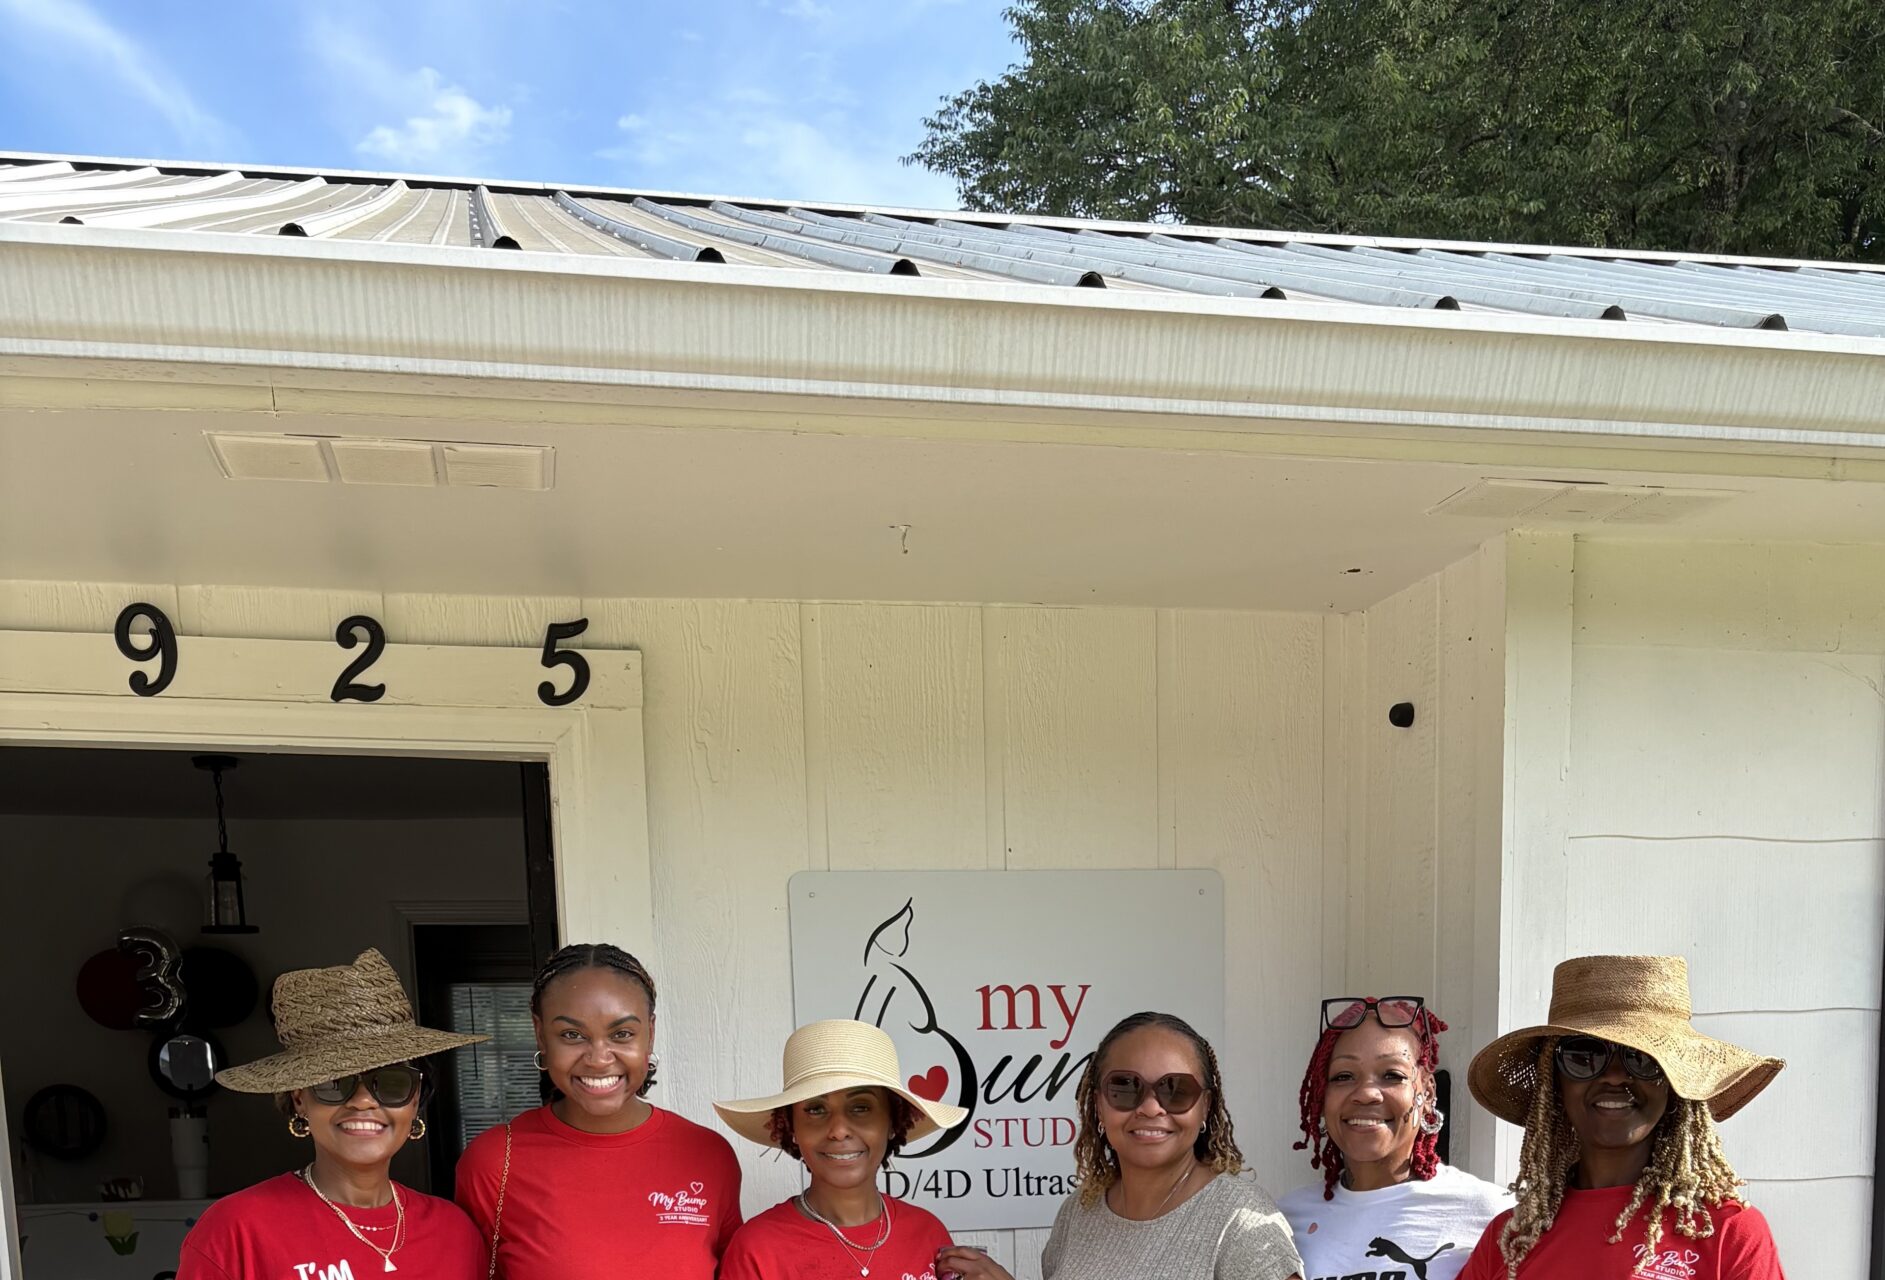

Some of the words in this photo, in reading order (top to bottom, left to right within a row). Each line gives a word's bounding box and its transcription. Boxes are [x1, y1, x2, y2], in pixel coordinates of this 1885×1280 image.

[114, 602, 178, 697] 9
[331, 615, 386, 702] 2
[538, 617, 590, 707] 5
[975, 984, 1092, 1049] my
[974, 1117, 1076, 1149] STUD
[882, 1168, 972, 1200] D/4D
[983, 1167, 1079, 1198] Ultras
[648, 1192, 675, 1210] My
[675, 1190, 707, 1210] Bump
[1655, 1264, 1685, 1277] STUDIO
[1661, 1250, 1696, 1276] Bump
